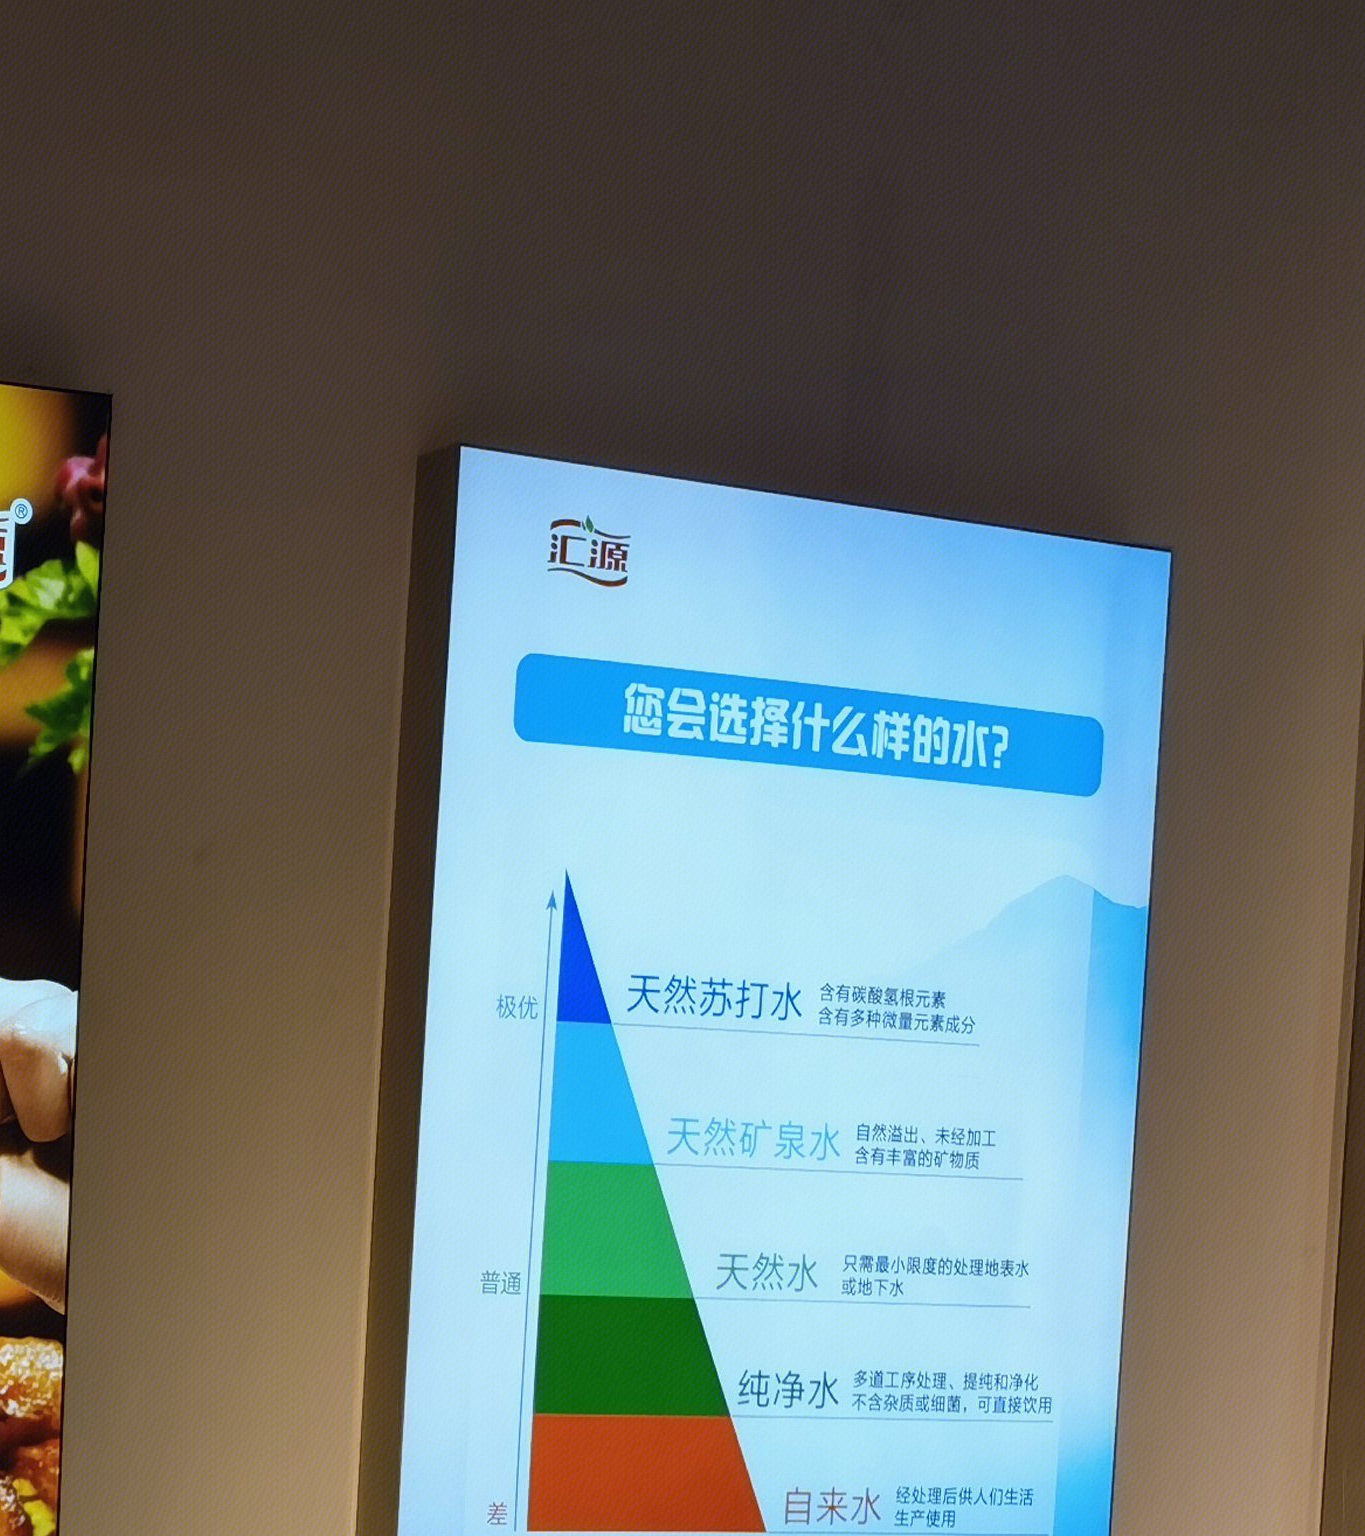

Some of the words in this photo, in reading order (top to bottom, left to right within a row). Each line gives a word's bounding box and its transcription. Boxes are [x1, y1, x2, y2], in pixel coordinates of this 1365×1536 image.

[547, 535, 630, 575] 汇源
[623, 682, 1010, 769] 您会选择什么样的水？
[496, 994, 539, 1021] 极优
[626, 974, 803, 1021] 天然苏打水
[819, 982, 947, 1010] 含有碳酸氢根元素
[817, 1008, 976, 1035] 含有多种微量元素成分
[667, 1117, 841, 1161] 天然矿泉水
[856, 1123, 997, 1147] 自然溢出、未经加工
[855, 1147, 981, 1170] 含有丰富的矿物质
[716, 1252, 819, 1292] 天然水
[842, 1253, 1030, 1278] 只需最小限度的处理地表水
[480, 1270, 523, 1296] 普通
[841, 1278, 904, 1298] 或地下水
[737, 1369, 839, 1409] 纯净水
[853, 1370, 1039, 1391] 多道工序处理、提纯和净化
[852, 1393, 1053, 1415] 不含杂质或细菌，可直接饮用
[784, 1487, 882, 1526] 自来水
[895, 1486, 1034, 1508] 经处理后供人们生活
[487, 1501, 508, 1527] 差
[894, 1509, 956, 1530] 生产使用
